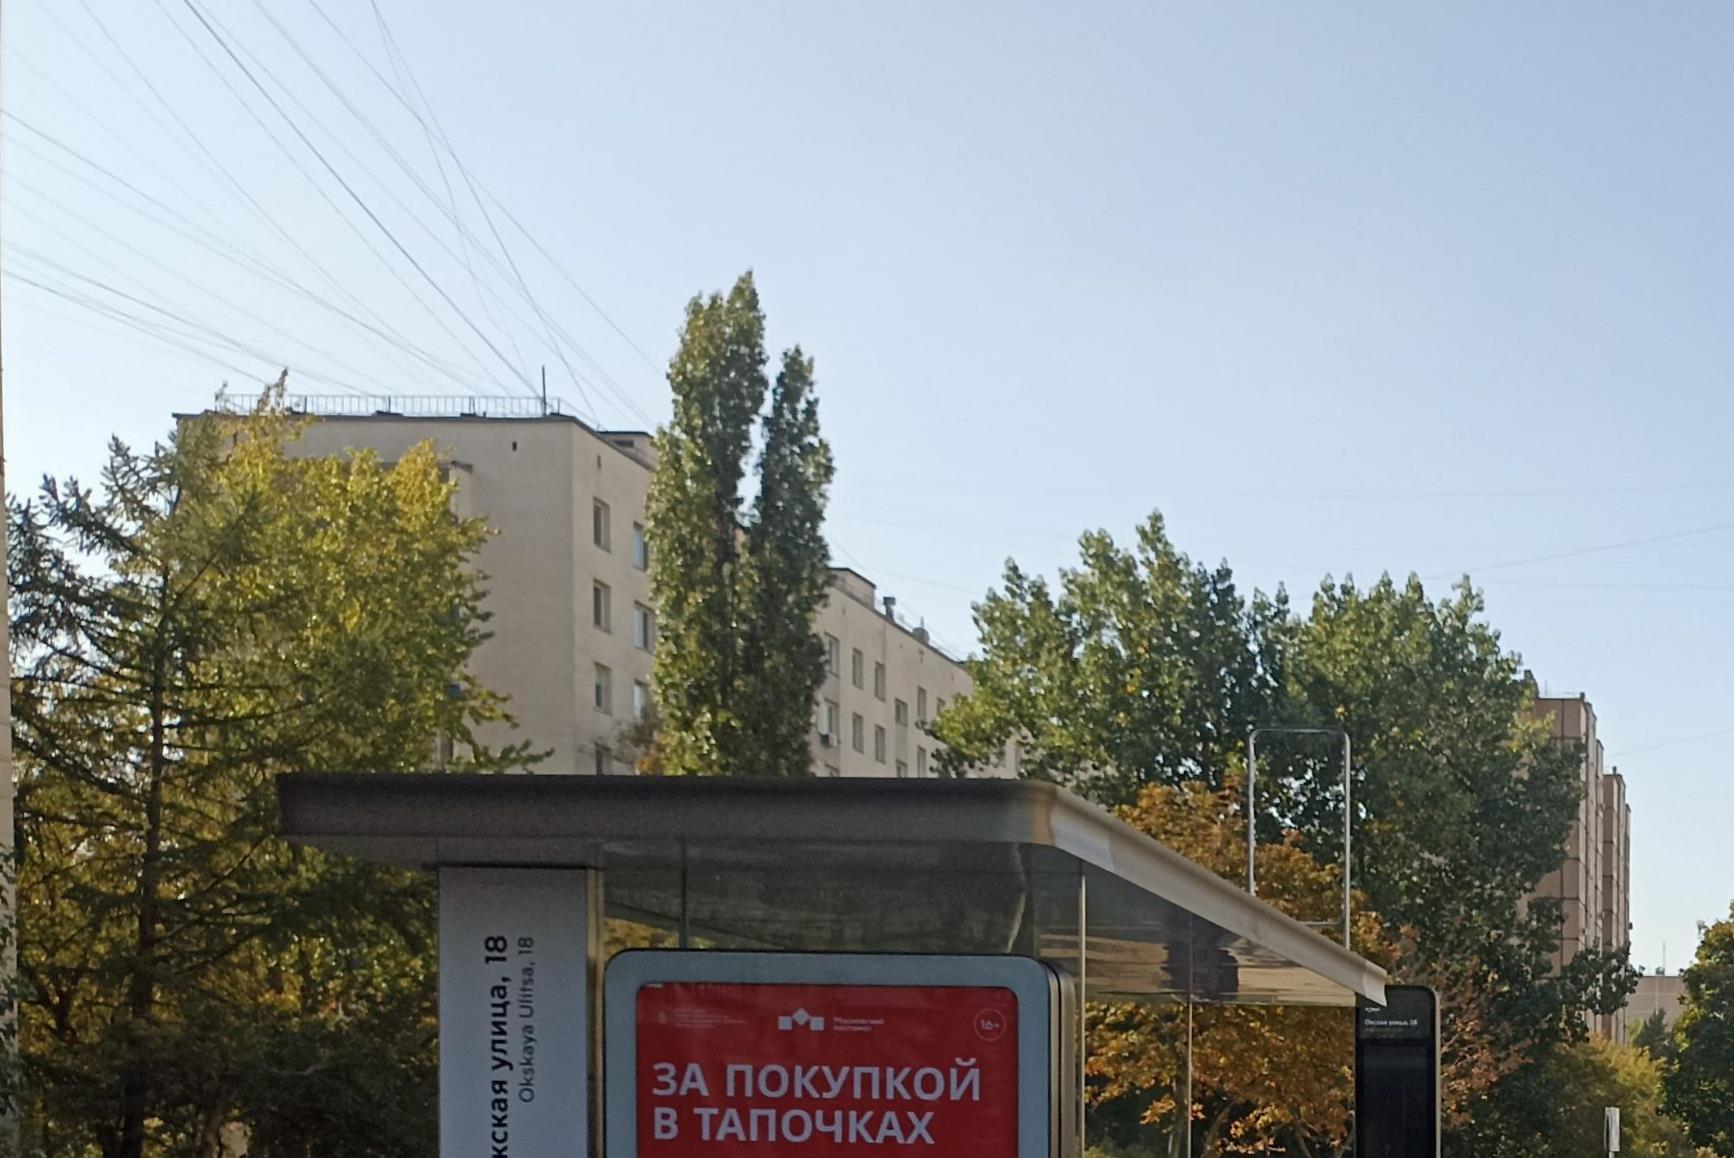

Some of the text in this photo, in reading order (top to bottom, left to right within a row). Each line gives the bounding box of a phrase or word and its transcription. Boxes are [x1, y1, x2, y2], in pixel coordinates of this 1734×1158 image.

[485, 935, 507, 964] 18
[490, 976, 514, 1071] улица,
[518, 936, 538, 1103] Okskaya Ulitsa, 18
[979, 1018, 1001, 1031] 16+
[652, 1057, 980, 1101] ЗА ПОКУПКОЙ
[653, 1106, 935, 1145] В ТАПОЧКАХ
